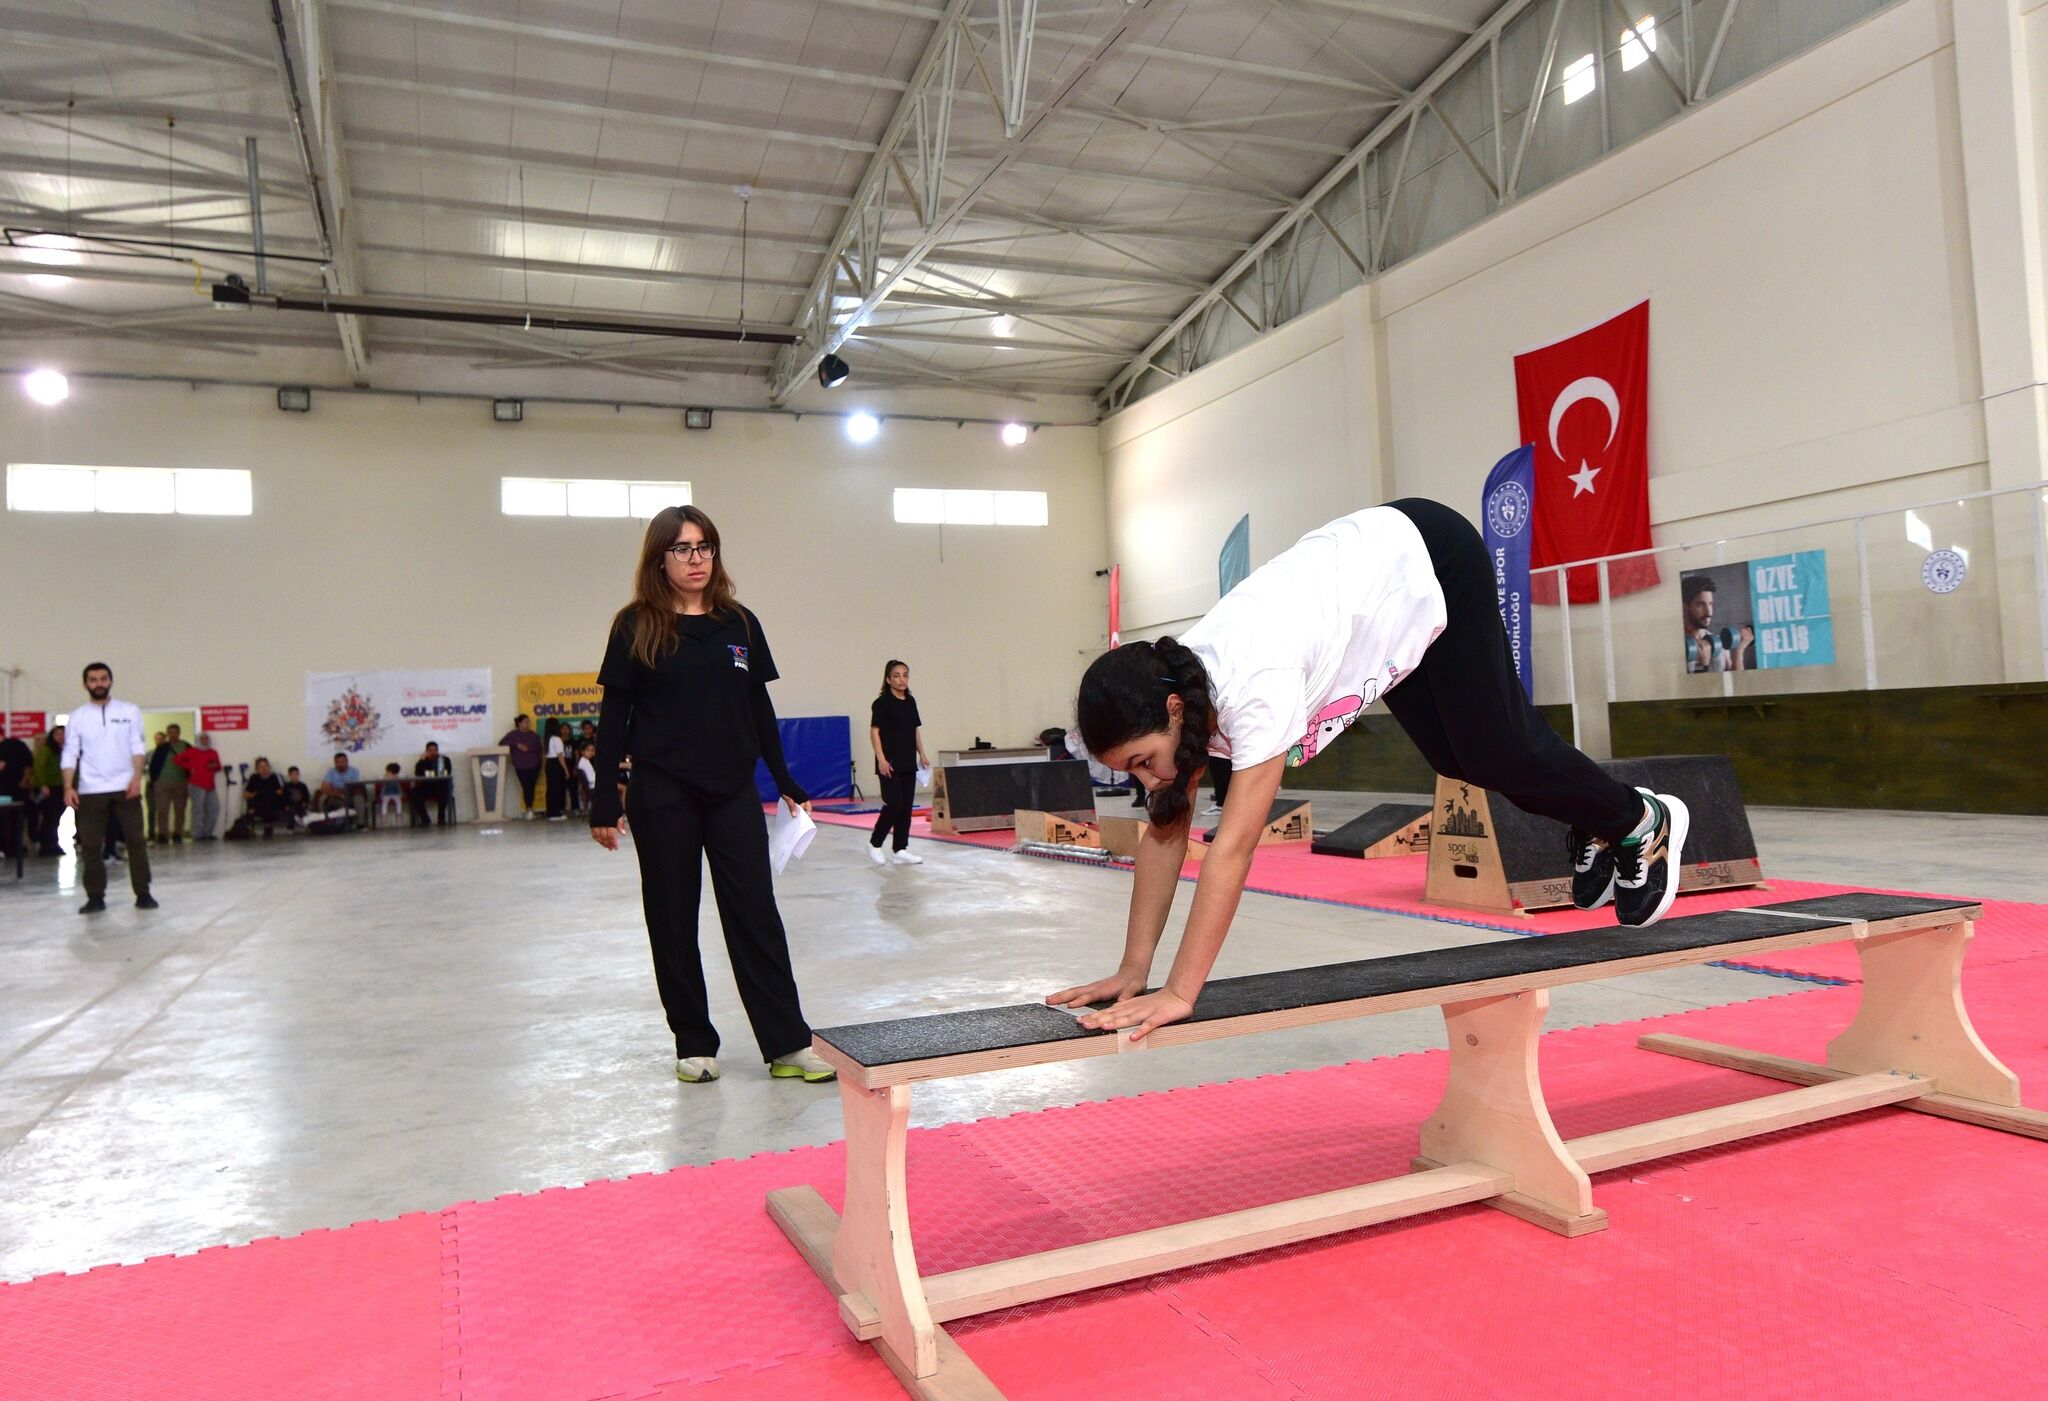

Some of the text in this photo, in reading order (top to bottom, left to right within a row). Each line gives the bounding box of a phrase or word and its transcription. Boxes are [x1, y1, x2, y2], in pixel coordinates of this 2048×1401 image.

[1496, 548, 1505, 585] SPOR
[1498, 588, 1505, 605] VE
[1511, 592, 1521, 678] DÜRLÜĞÜ
[1761, 623, 1809, 654] GELİŞ
[557, 687, 604, 697] OSMANİY
[400, 703, 487, 718] OKUL SPORLARI
[533, 704, 571, 718] OKUL
[1543, 879, 1571, 897] spor1
